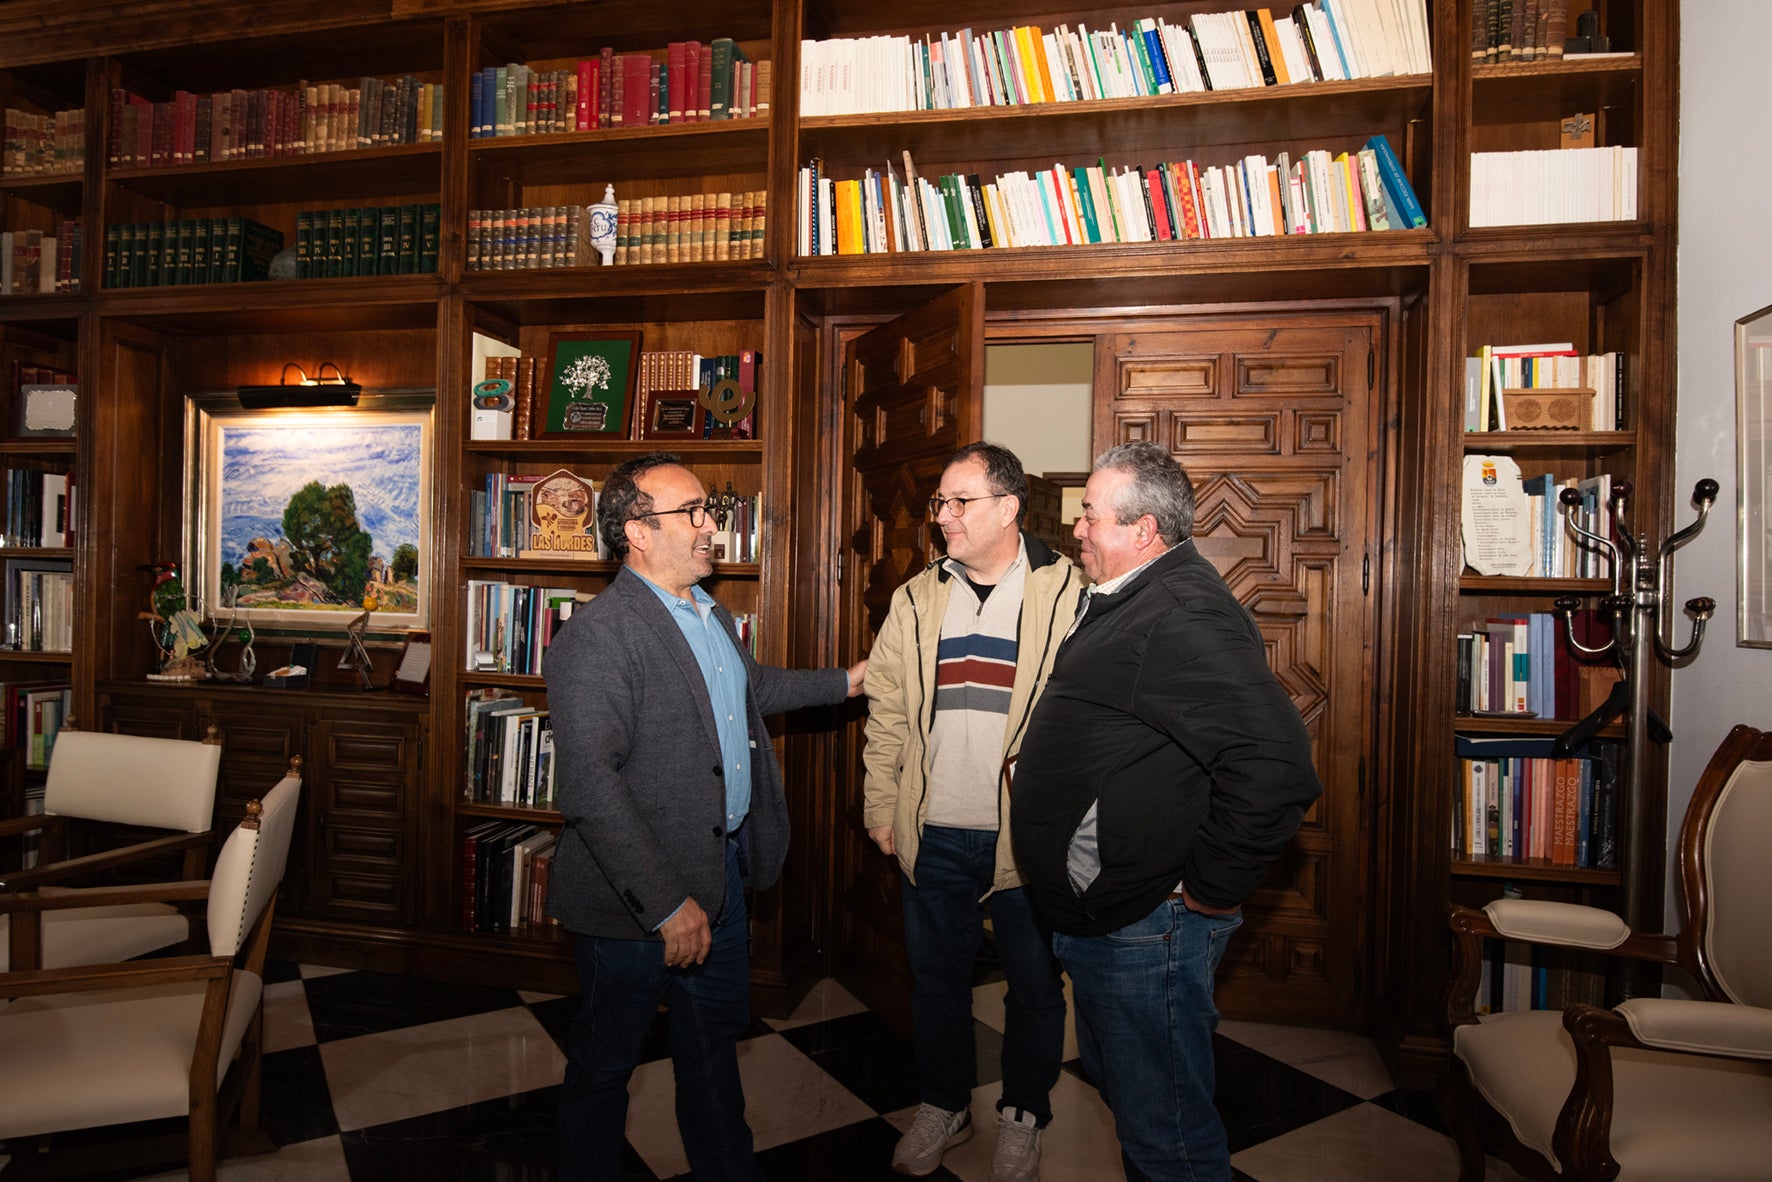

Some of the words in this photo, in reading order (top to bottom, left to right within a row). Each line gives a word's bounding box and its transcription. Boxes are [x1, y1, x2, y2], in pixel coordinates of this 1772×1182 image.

[533, 534, 551, 550] LAS
[1554, 777, 1565, 845] MAESTRAZGO
[1566, 777, 1576, 846] MAESTRAZGO
